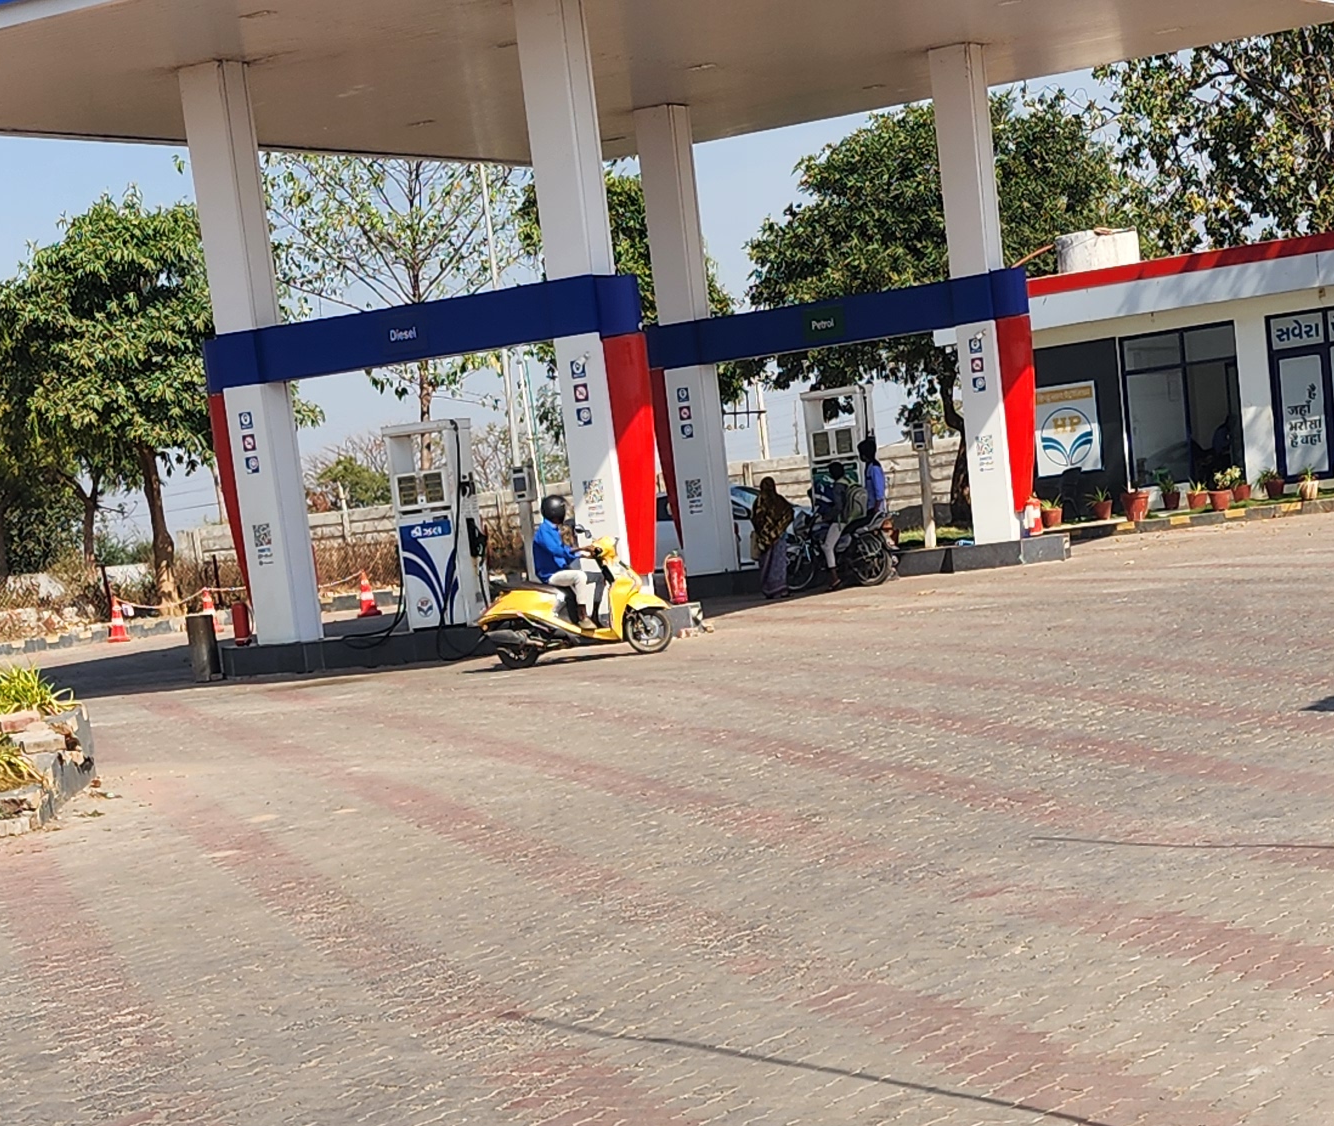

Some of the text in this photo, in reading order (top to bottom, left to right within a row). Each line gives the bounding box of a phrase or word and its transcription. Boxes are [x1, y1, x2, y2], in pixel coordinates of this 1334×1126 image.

[811, 317, 835, 330] Petrol
[1276, 319, 1320, 342] સવેરા
[389, 326, 417, 341] Diesel
[1052, 415, 1082, 434] HP
